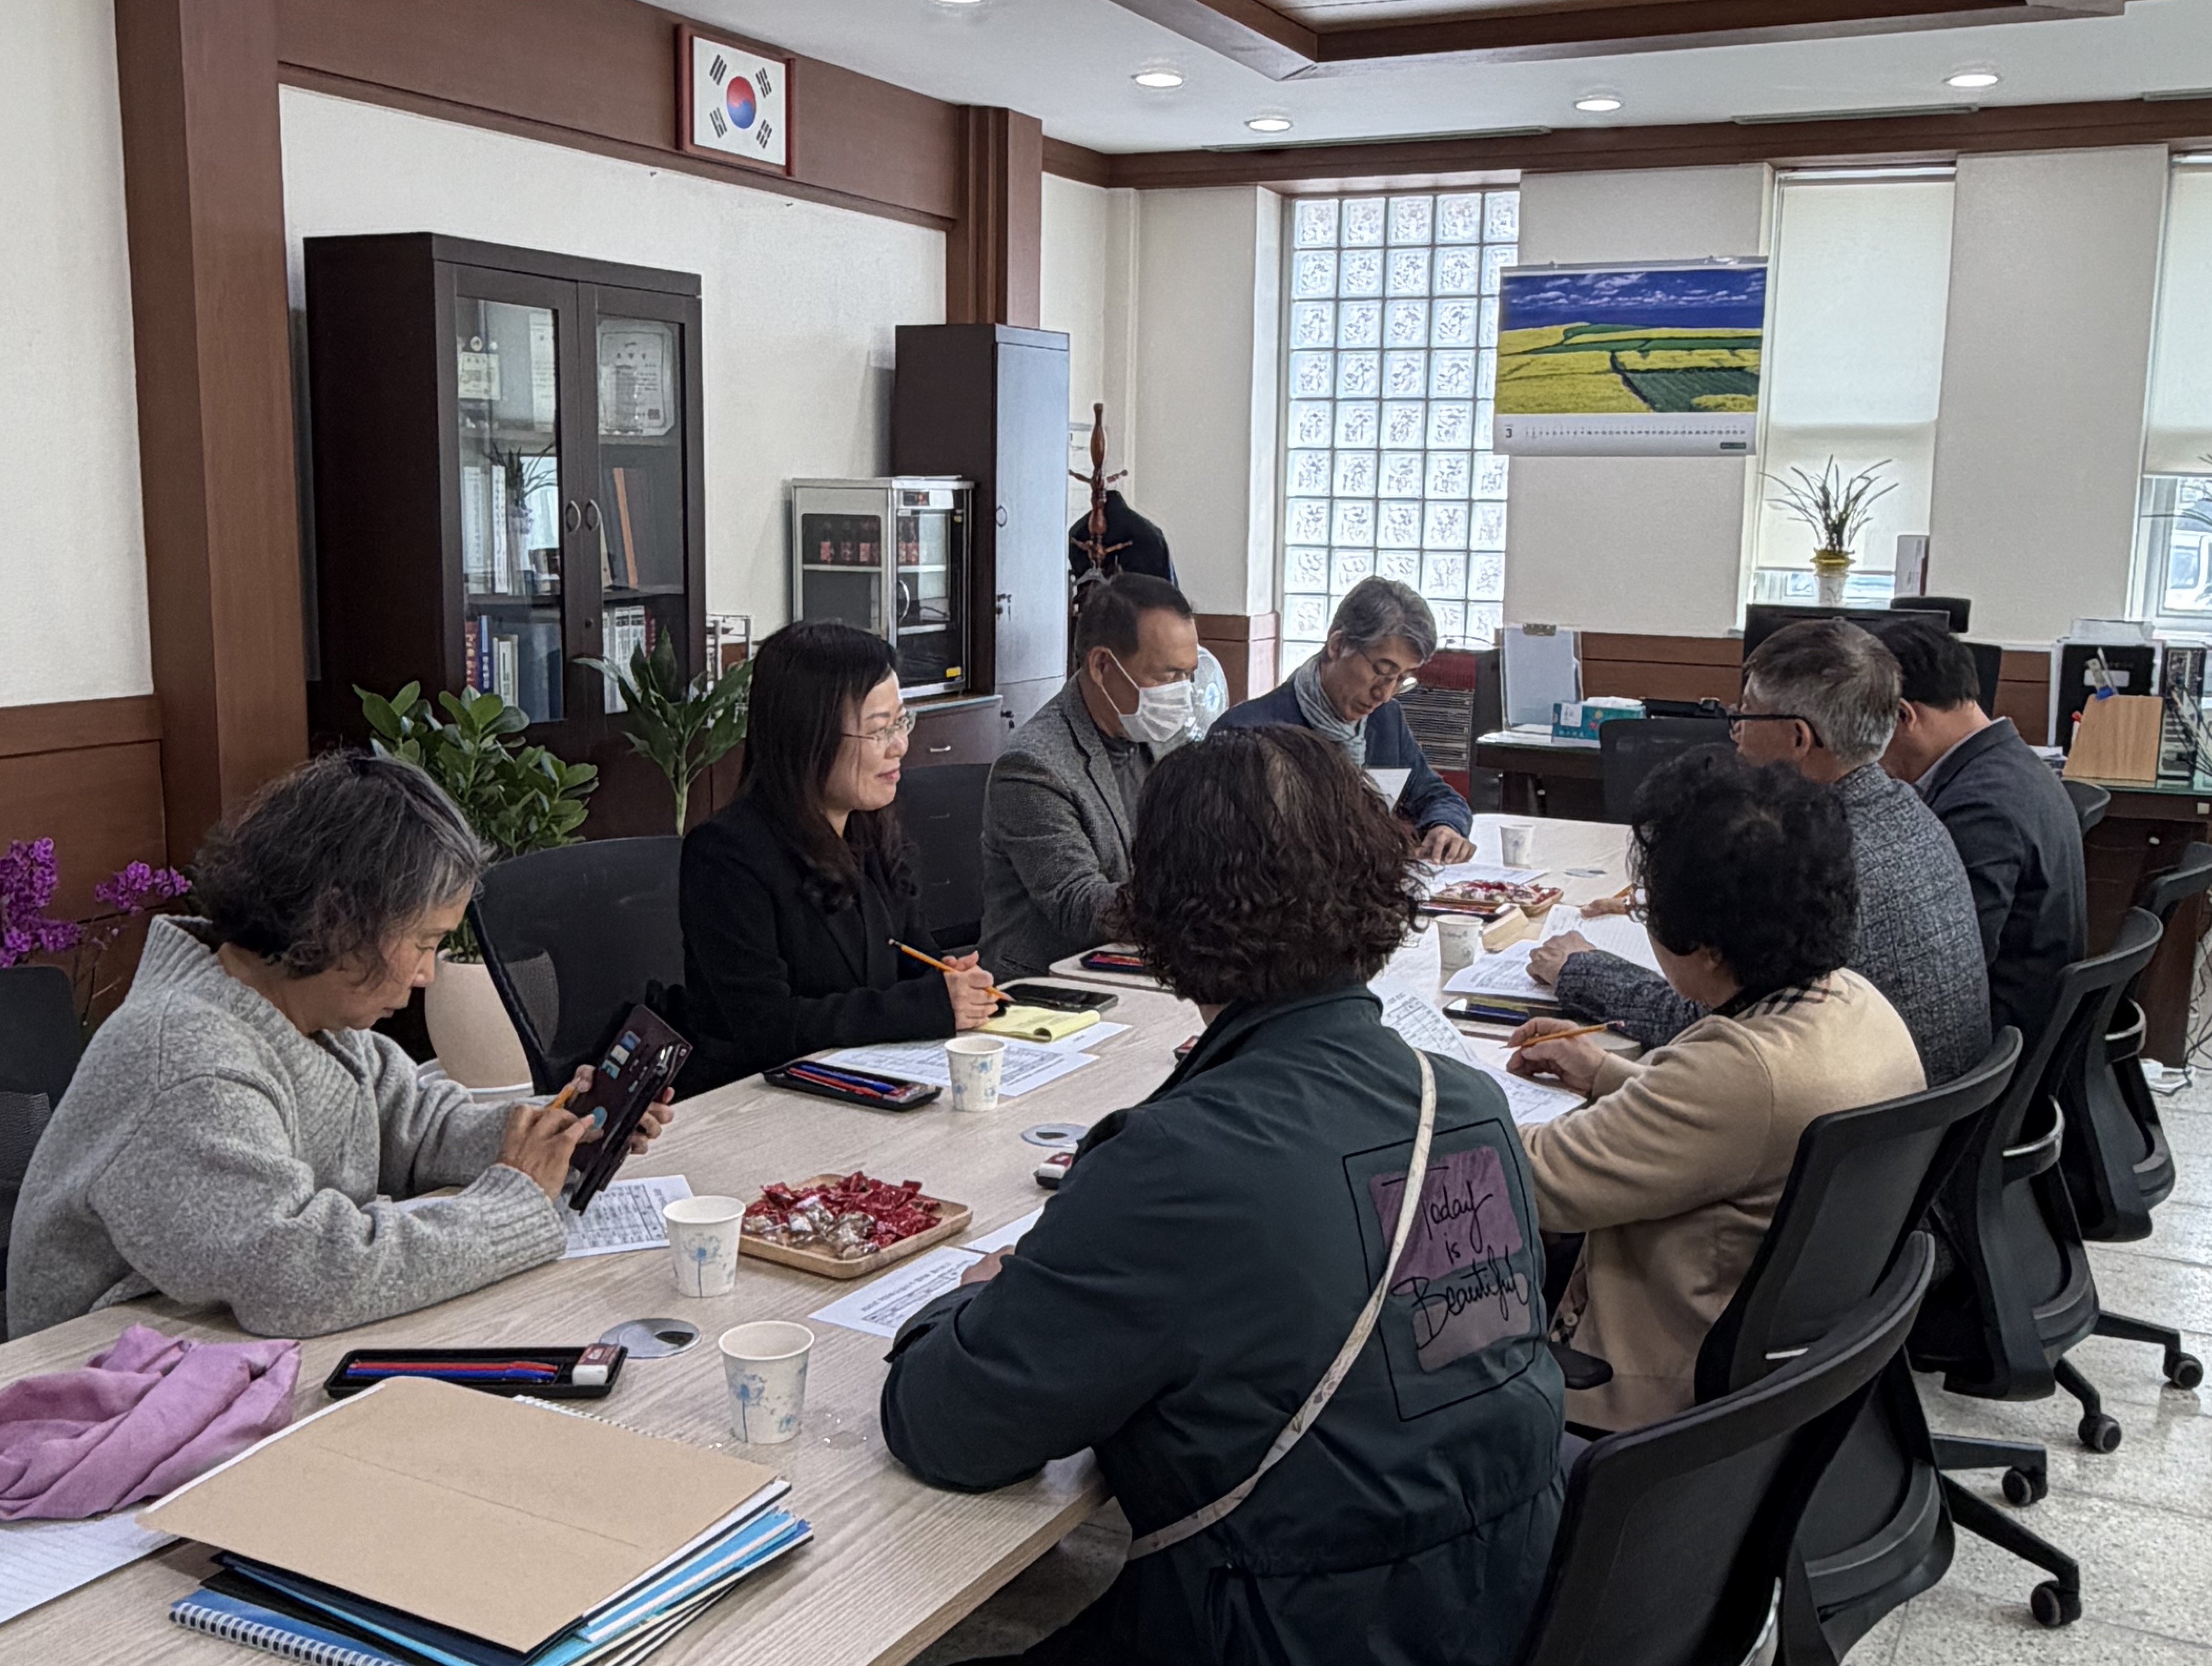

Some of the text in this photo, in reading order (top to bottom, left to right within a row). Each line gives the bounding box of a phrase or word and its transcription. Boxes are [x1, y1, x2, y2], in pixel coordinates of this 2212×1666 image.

[1381, 1165, 1493, 1253] Today
[1444, 1232, 1461, 1264] is
[1390, 1245, 1530, 1350] Beautiful
